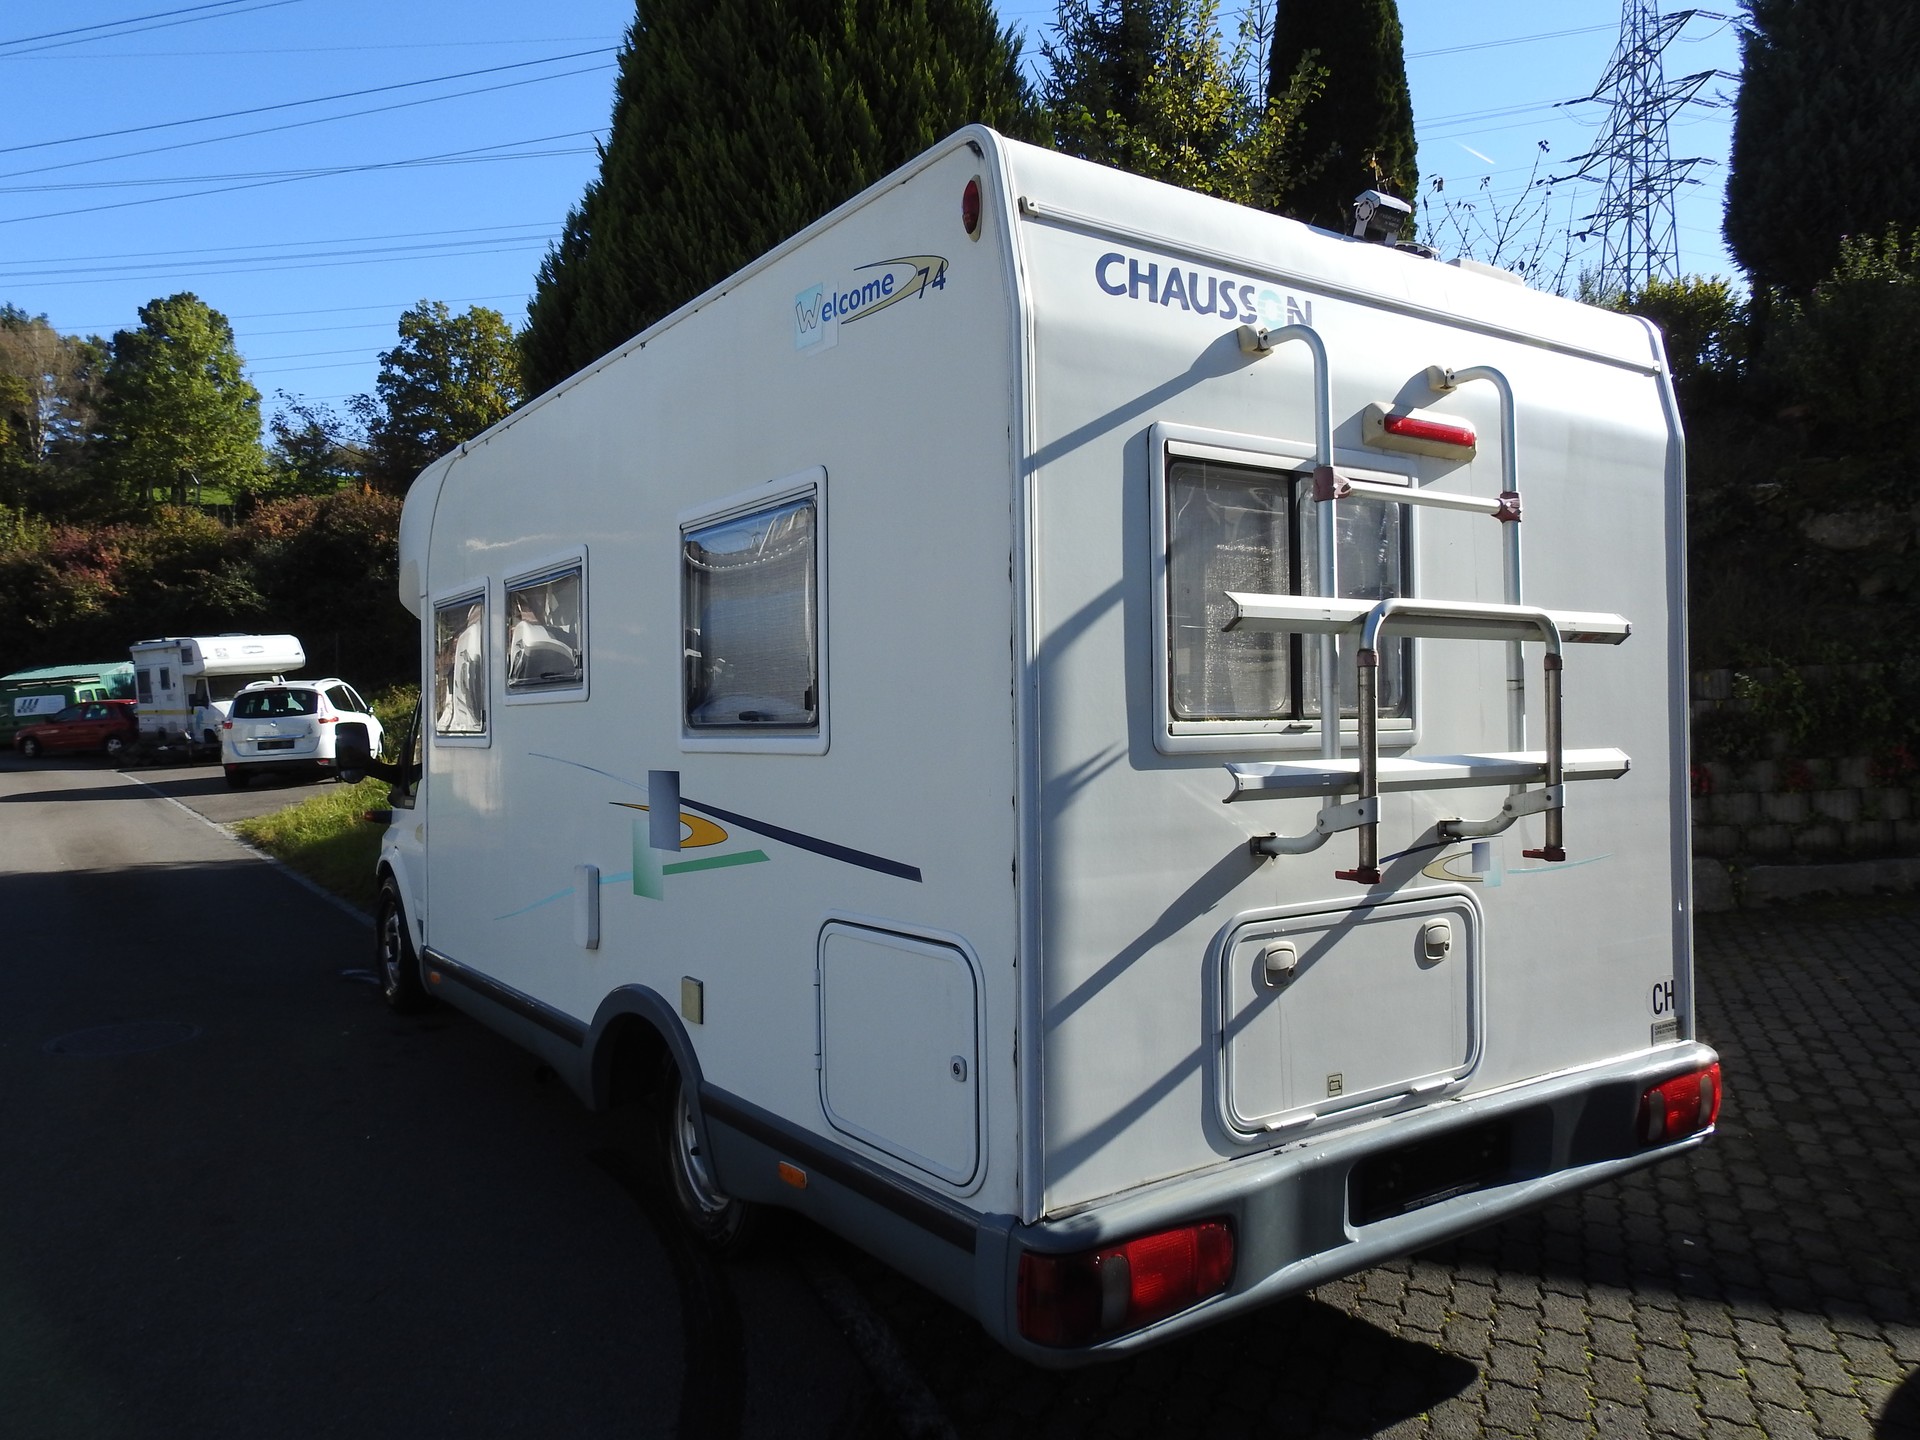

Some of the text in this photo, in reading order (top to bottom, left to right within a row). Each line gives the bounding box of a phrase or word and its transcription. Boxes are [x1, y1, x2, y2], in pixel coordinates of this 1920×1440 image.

[795, 260, 946, 334] Welcome 74
[1095, 252, 1313, 329] CHAUSSON
[1652, 980, 1676, 1015] CH
